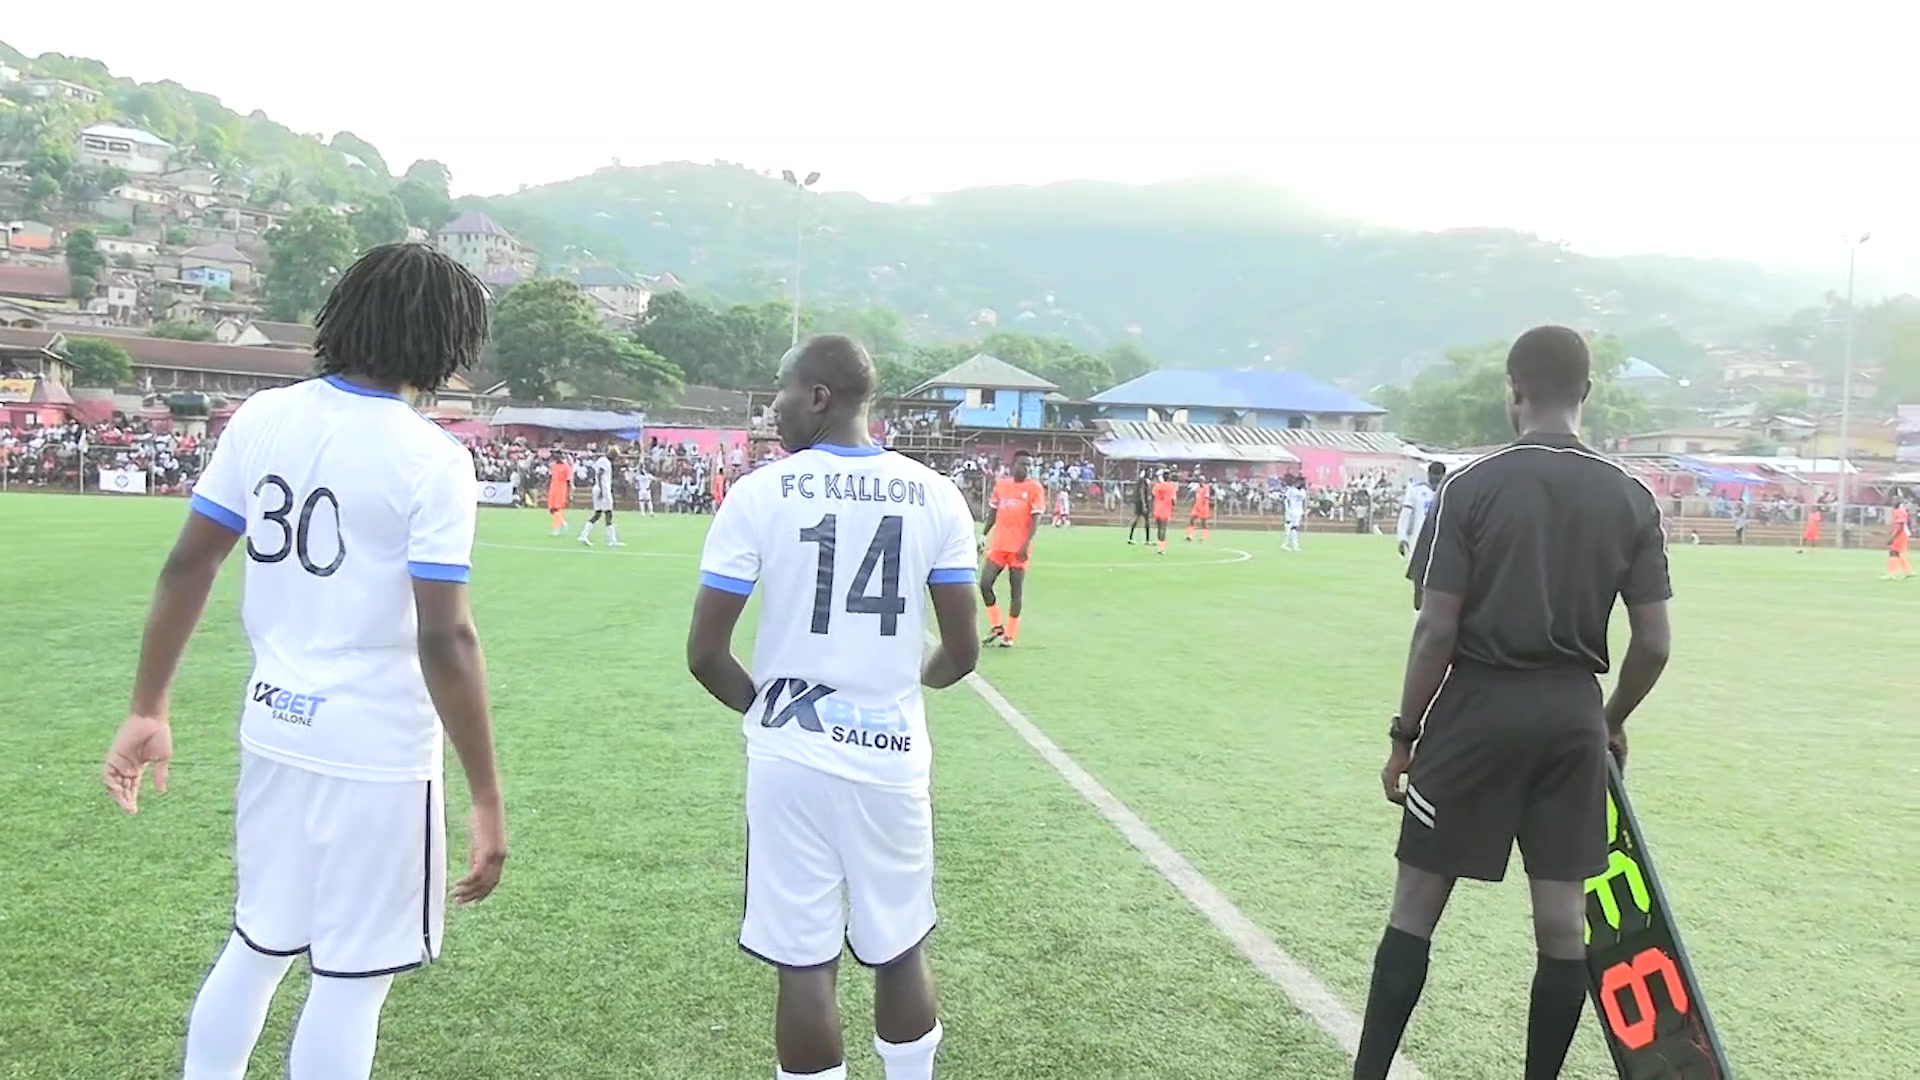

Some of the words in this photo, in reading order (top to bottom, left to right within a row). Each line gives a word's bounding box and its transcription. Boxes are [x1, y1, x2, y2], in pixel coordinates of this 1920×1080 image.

[781, 473, 815, 499] FC
[824, 474, 925, 505] KALLON
[247, 474, 346, 577] 30
[800, 513, 906, 637] 14
[272, 709, 312, 727] SALONE
[831, 725, 911, 752] SALONE
